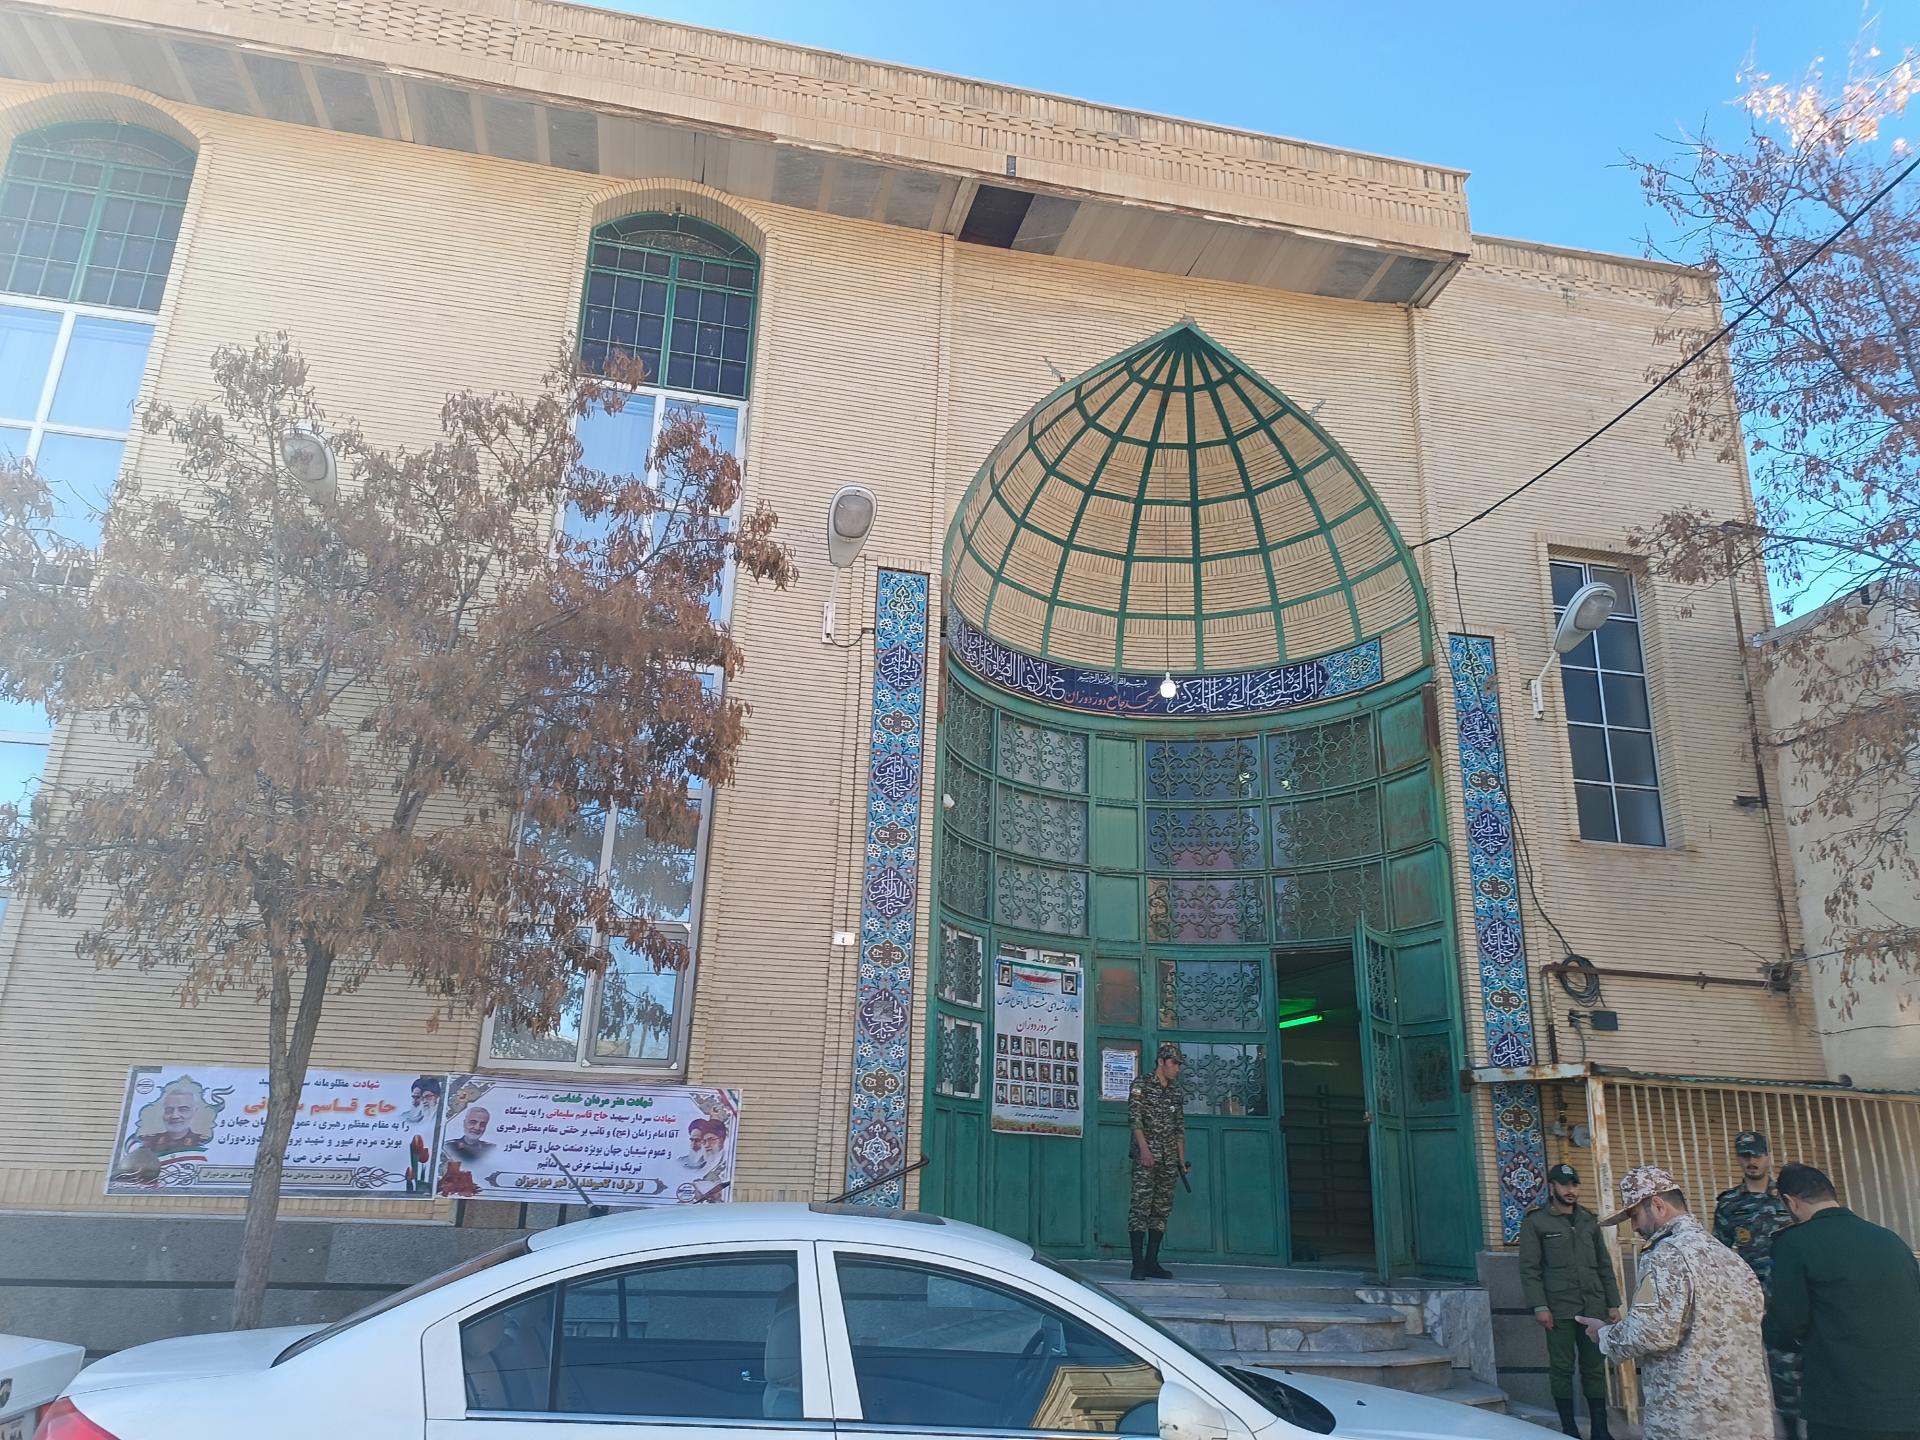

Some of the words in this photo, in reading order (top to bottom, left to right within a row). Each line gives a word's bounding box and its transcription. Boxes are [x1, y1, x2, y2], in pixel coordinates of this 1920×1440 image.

[1016, 1017, 1048, 1033] دوزدوزان
[1044, 1015, 1060, 1036] شهر
[313, 1078, 349, 1089] مظلومانه
[352, 1080, 380, 1089] شهادت
[551, 1091, 584, 1104] خداست
[583, 1094, 610, 1108] مردان
[609, 1096, 626, 1109] هنر
[626, 1095, 654, 1109] شهادت
[309, 1097, 358, 1116] قاسم
[363, 1099, 397, 1117] حاج
[504, 1105, 529, 1117] پیشگاه
[528, 1107, 537, 1116] به
[537, 1107, 545, 1119] را
[546, 1108, 575, 1119] سلیمانی
[575, 1110, 592, 1120] قاسم
[593, 1111, 609, 1122] حاج
[609, 1112, 630, 1123] سپهبد
[630, 1112, 652, 1124] سردار
[652, 1113, 677, 1123] شهادت
[227, 1118, 250, 1129] جهان
[293, 1120, 311, 1132] عمو
[347, 1120, 370, 1131] معظم
[371, 1121, 390, 1131] مقام
[392, 1123, 400, 1132] به
[401, 1122, 410, 1132] را
[496, 1121, 521, 1133] رهبری
[521, 1122, 542, 1133] معظم
[541, 1123, 559, 1133] مقام
[580, 1127, 588, 1137] بر
[652, 1128, 669, 1139] امام
[287, 1136, 302, 1147] پرو
[304, 1135, 325, 1145] شهید
[355, 1137, 378, 1148] مردم
[380, 1138, 402, 1147] بویژه
[503, 1139, 524, 1152] کشور
[523, 1140, 537, 1152] نقل
[545, 1141, 562, 1154] حمل
[562, 1143, 584, 1153] صنعت
[584, 1145, 603, 1156] بویژه
[603, 1146, 623, 1157] جهان
[623, 1145, 648, 1157] شیعیان
[335, 1152, 361, 1163] تسلیت
[648, 1147, 666, 1158] عموم
[292, 1154, 307, 1164] می
[309, 1154, 333, 1164] عرض
[571, 1160, 592, 1172] عرض
[592, 1160, 615, 1171] تسلیت
[622, 1162, 643, 1174] تبریک
[635, 1180, 645, 1192] از
